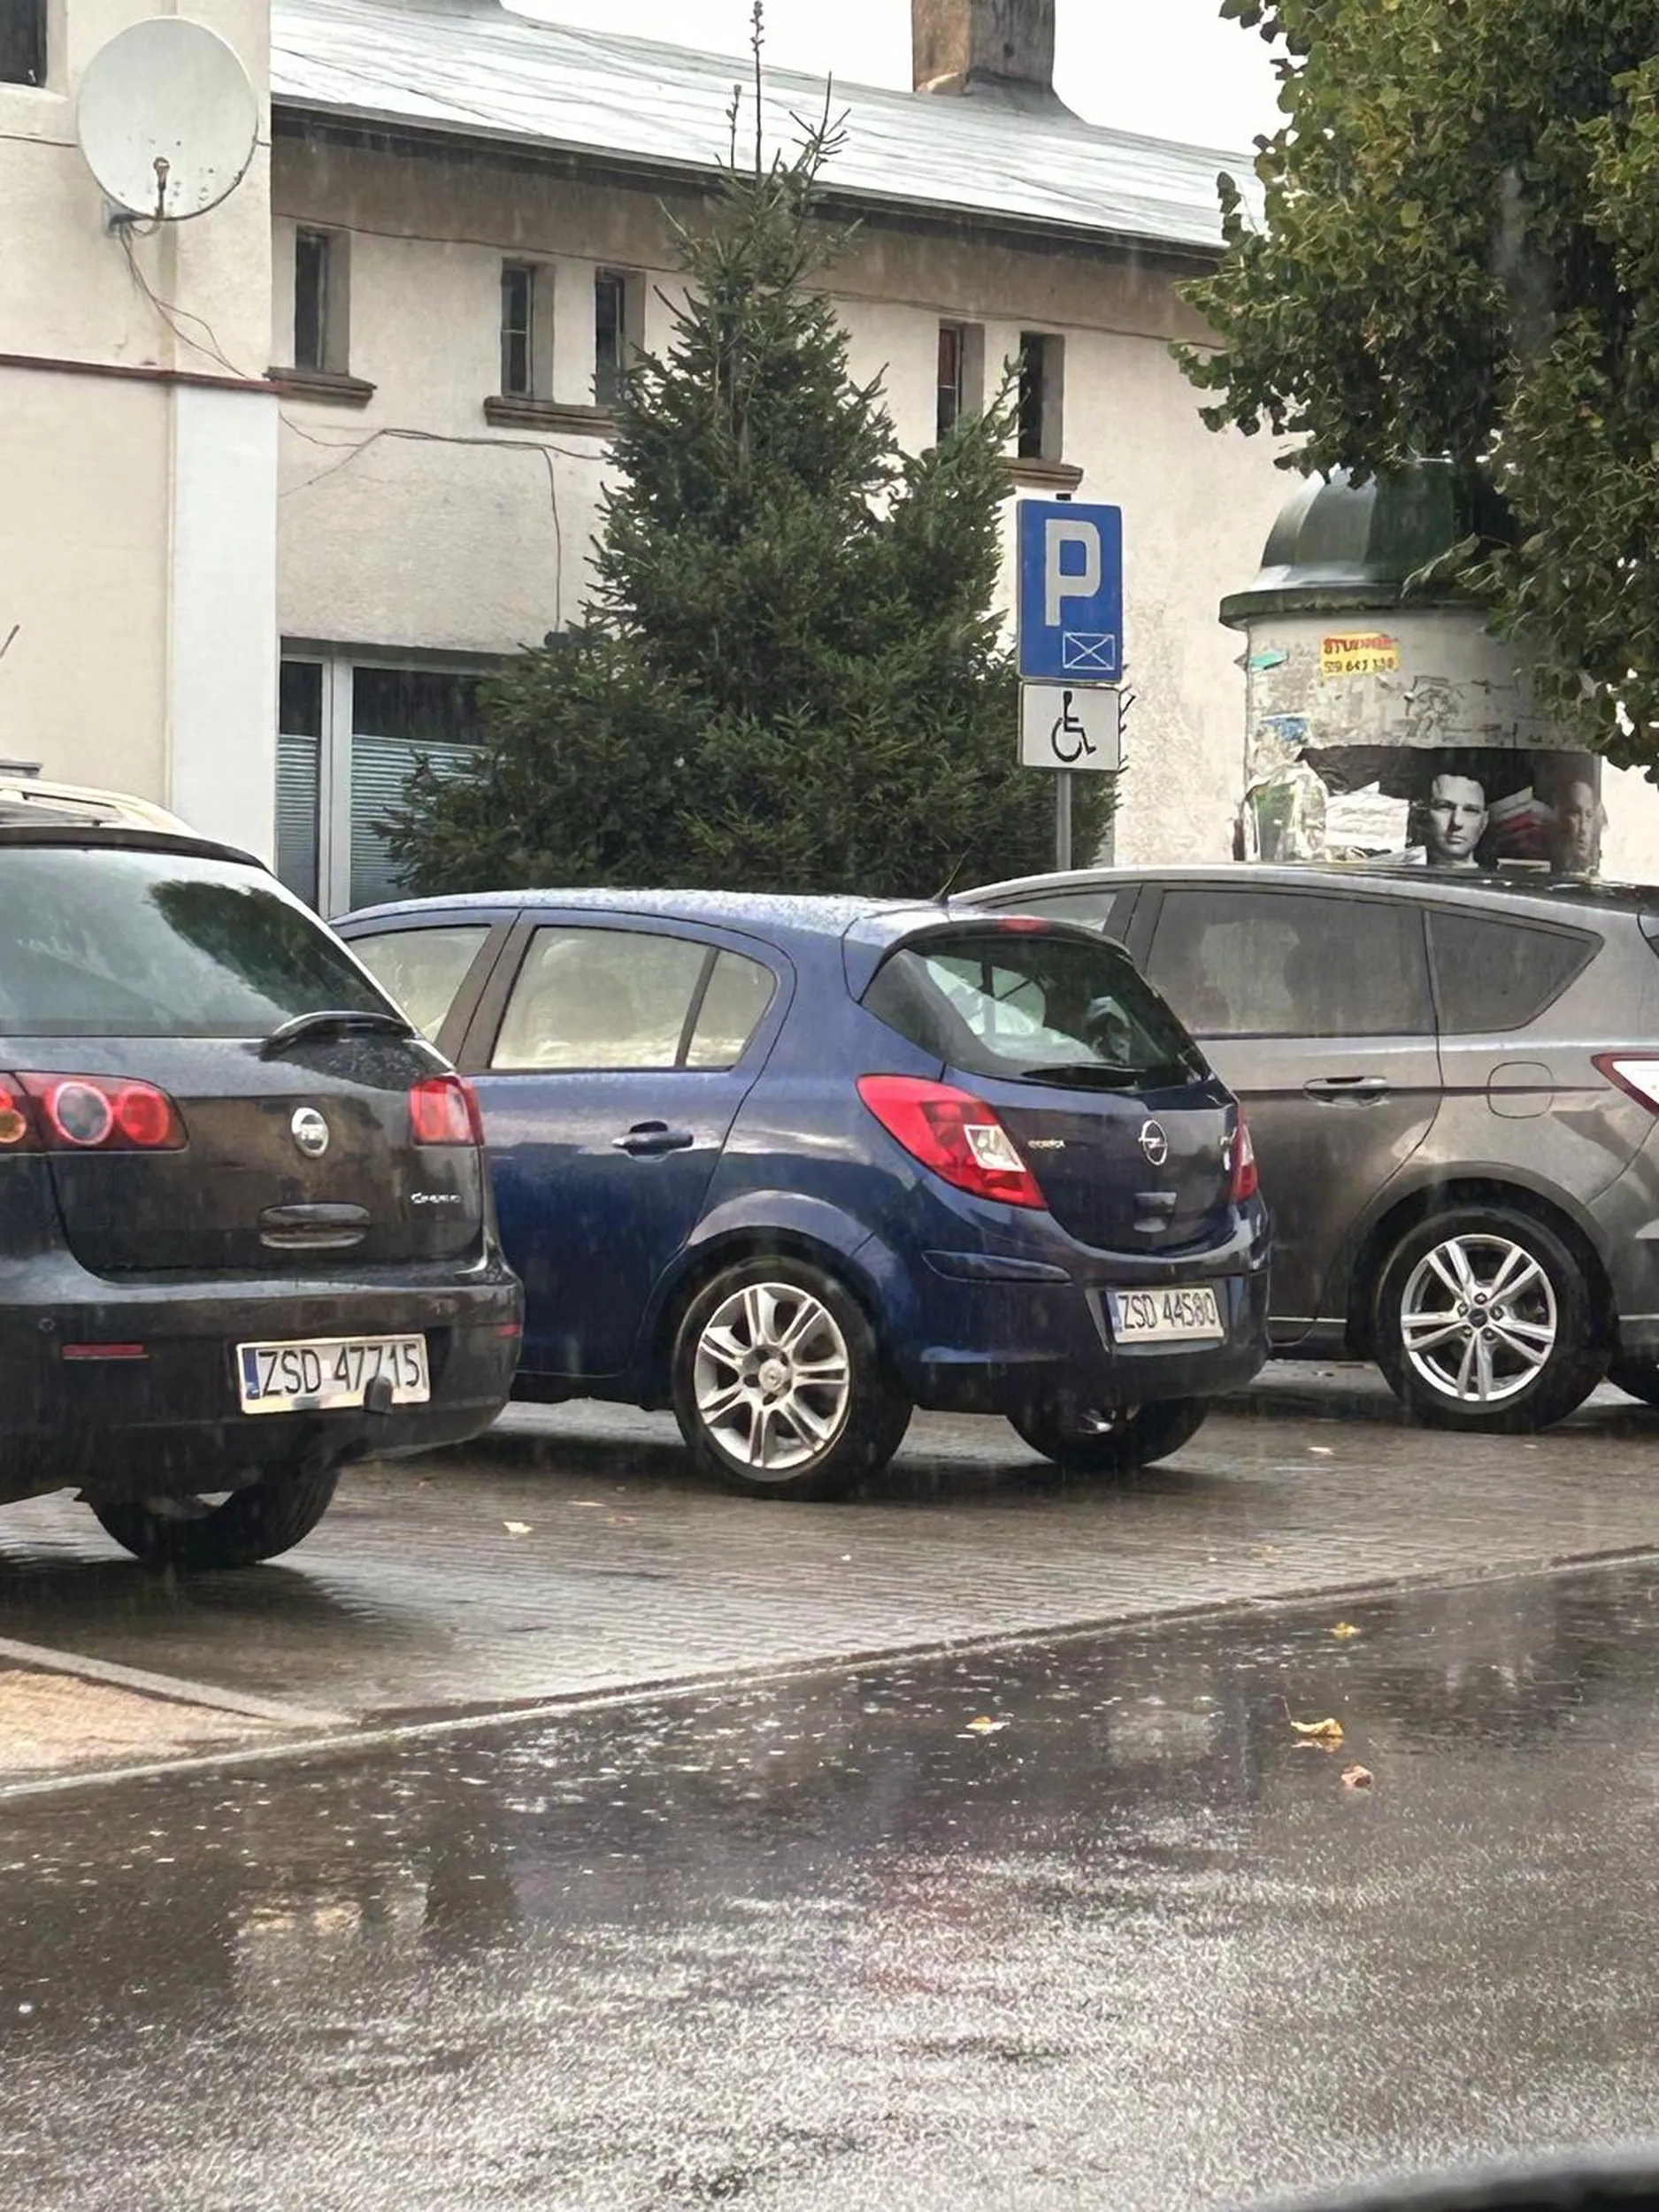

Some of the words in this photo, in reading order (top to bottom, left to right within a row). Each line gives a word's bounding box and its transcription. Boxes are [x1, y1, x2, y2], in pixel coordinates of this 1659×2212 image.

[1045, 518, 1101, 626] P
[1118, 1294, 1157, 1330] ZSD
[257, 1348, 322, 1398] ZSD
[332, 1342, 421, 1391] 47715
